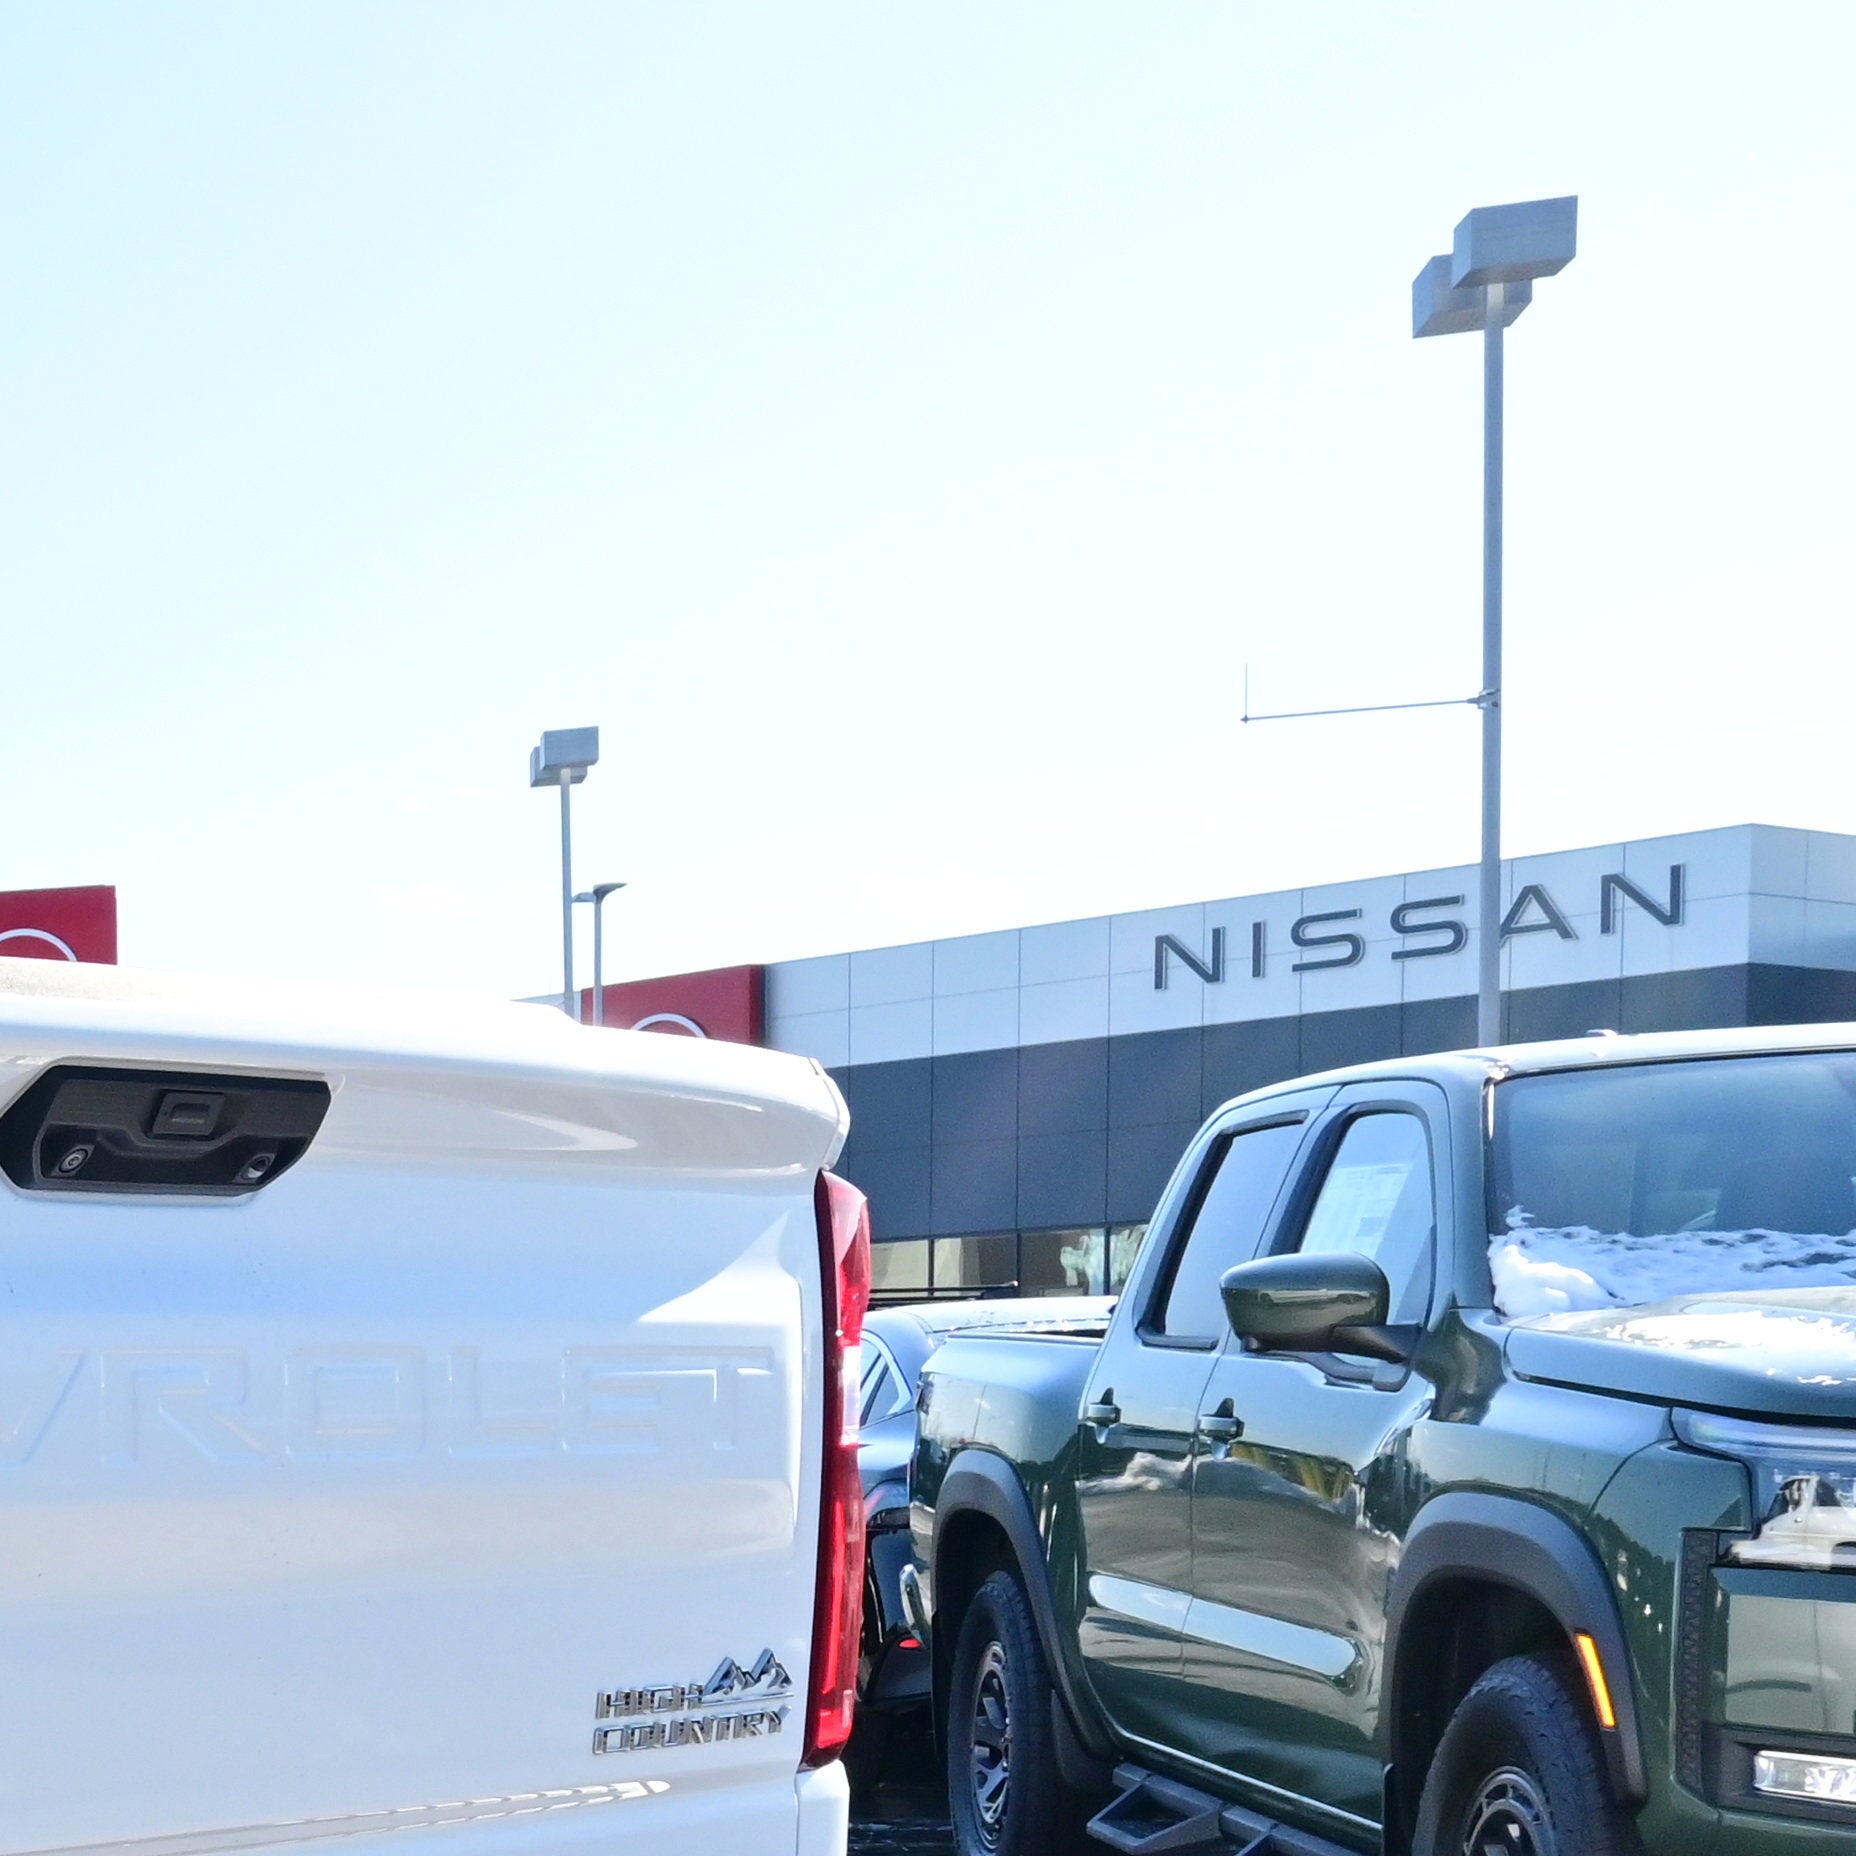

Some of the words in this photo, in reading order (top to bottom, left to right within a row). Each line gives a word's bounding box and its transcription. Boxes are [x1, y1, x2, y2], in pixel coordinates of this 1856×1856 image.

[1154, 863, 1686, 991] NISSAN
[595, 1683, 704, 1720] HIGH
[592, 1704, 793, 1755] COUNTRY
